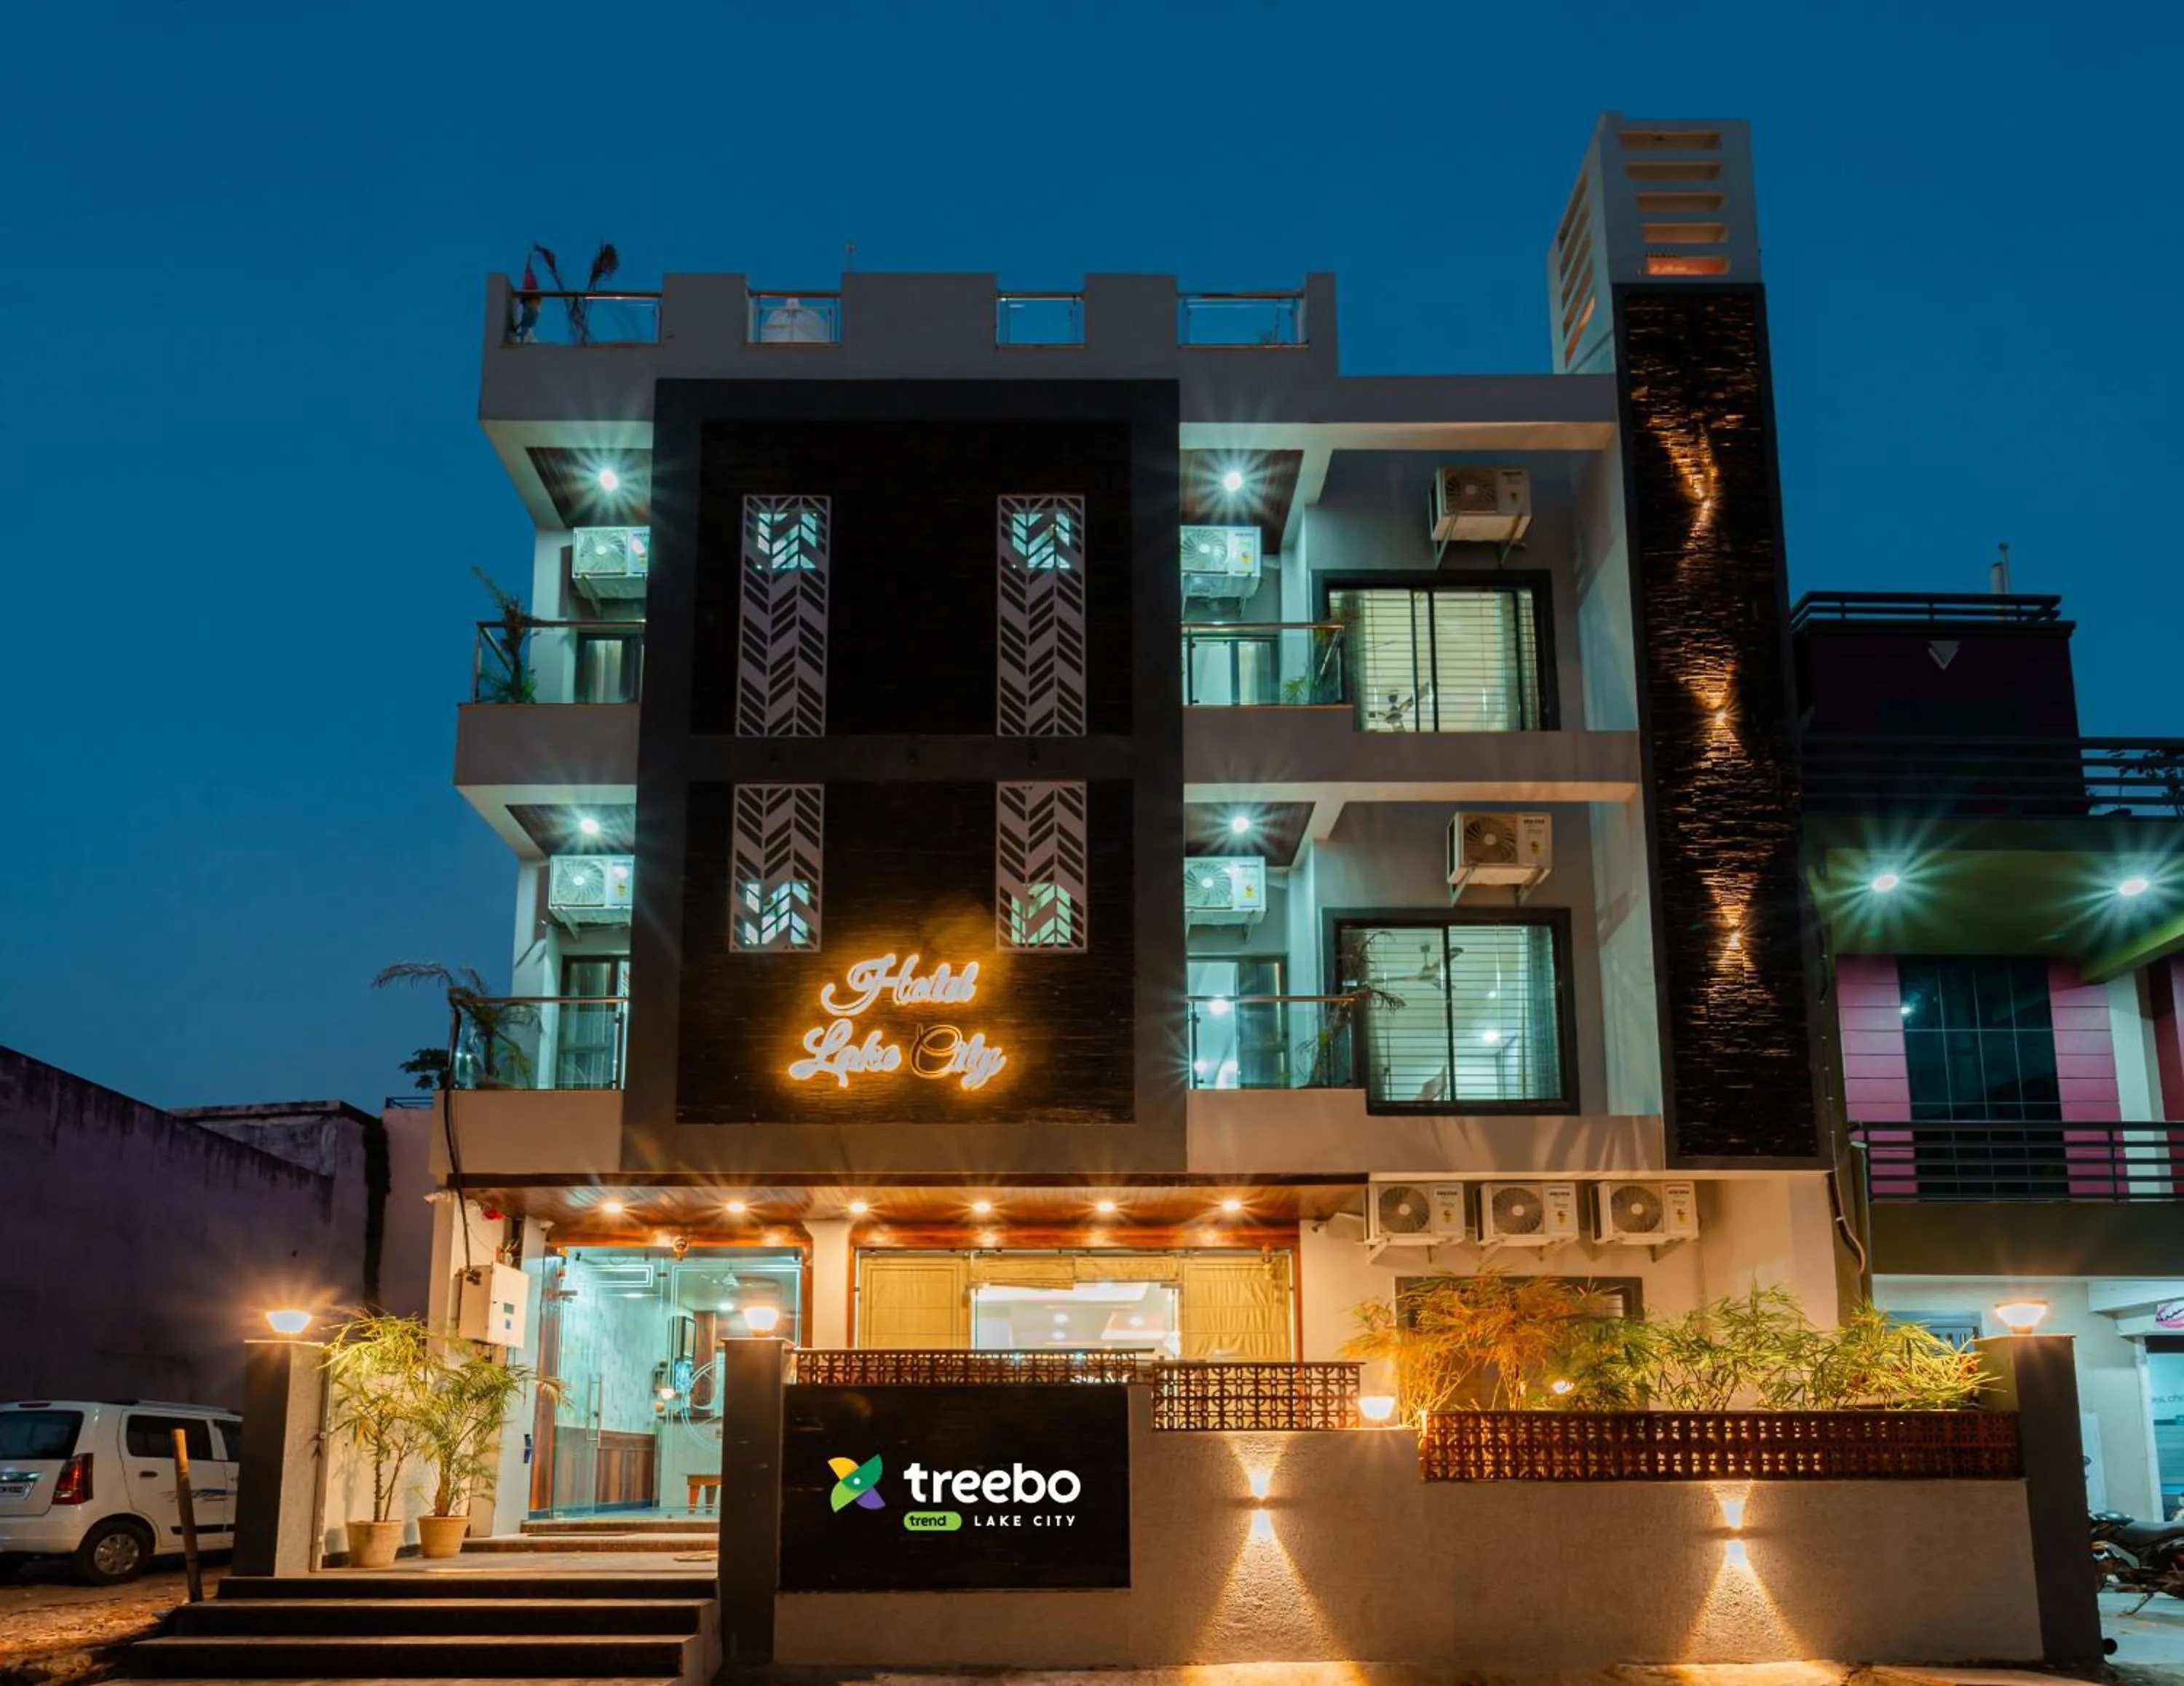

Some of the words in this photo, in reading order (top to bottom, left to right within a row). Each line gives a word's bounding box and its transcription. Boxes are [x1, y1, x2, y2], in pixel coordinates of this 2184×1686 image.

[820, 954, 980, 1016] Hotel
[788, 1018, 901, 1088] Lake
[911, 1024, 1006, 1091] City
[903, 1463, 1081, 1503] treebo
[909, 1514, 946, 1527] trend
[974, 1515, 1021, 1527] LAKE
[1033, 1515, 1076, 1527] CITY
